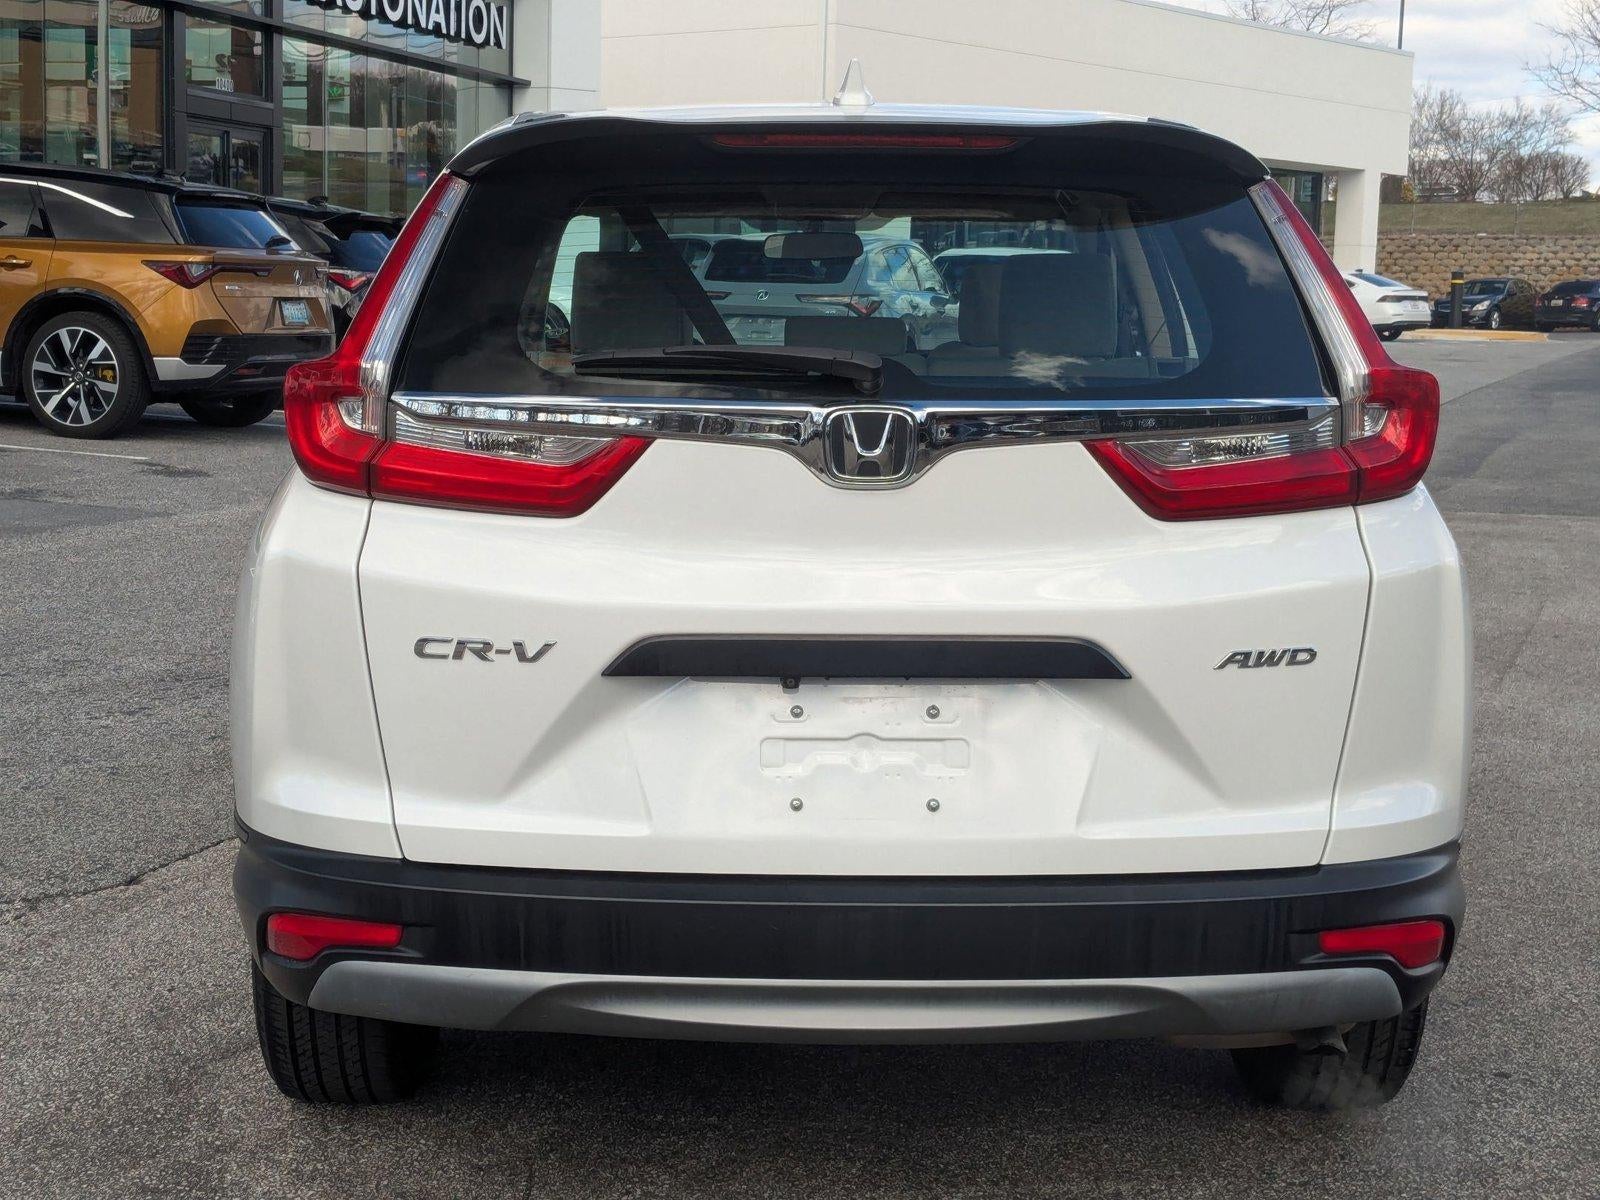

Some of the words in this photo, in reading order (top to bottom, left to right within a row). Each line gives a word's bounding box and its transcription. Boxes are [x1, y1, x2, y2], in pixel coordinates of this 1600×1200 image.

[320, 0, 506, 50] NATION
[414, 636, 558, 663] CR-V
[1213, 647, 1318, 670] AWD
